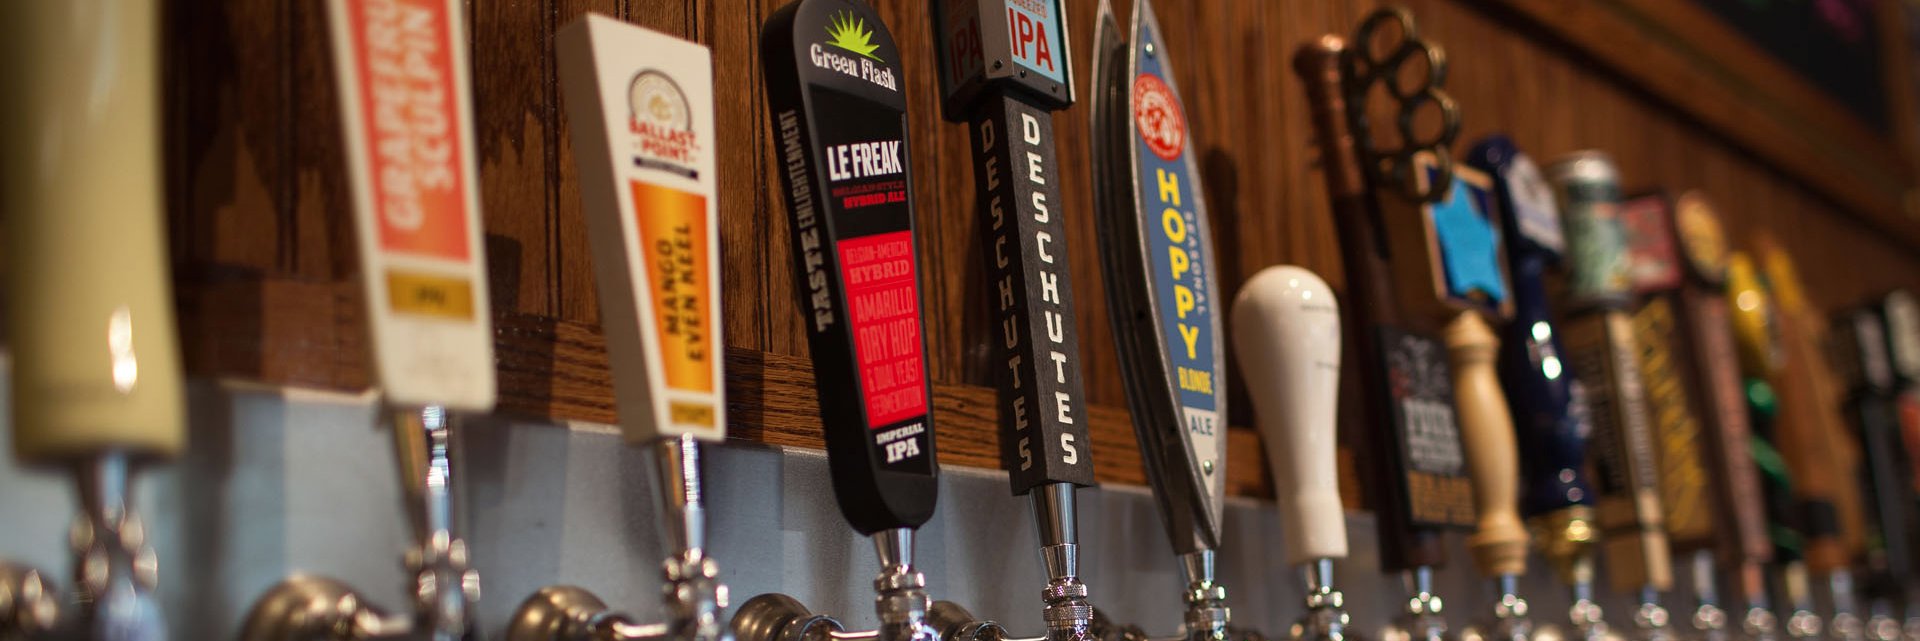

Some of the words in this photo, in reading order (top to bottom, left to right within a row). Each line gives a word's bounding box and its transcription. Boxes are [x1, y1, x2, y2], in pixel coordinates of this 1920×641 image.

[950, 16, 983, 85] IPA
[1009, 6, 1054, 72] IPA
[811, 43, 858, 78] Green
[861, 57, 897, 92] Flash
[402, 7, 455, 190] SCULPIN
[629, 117, 696, 148] BALLAST
[642, 139, 688, 163] POINT
[779, 109, 816, 227] ENLIGHTENMENT
[827, 145, 851, 181] LE
[851, 141, 902, 178] FREAK
[844, 193, 886, 209] HYBRID
[887, 191, 906, 203] ALE
[674, 223, 696, 286] KEEL
[849, 259, 910, 285] HYBRID
[1156, 168, 1199, 360] HOPPY
[1184, 210, 1206, 315] SEASONAL
[656, 239, 680, 336] MANGO
[800, 228, 835, 332] TASTE
[855, 286, 914, 323] AMARILLO
[980, 119, 1033, 472] DESCHUTES
[1021, 112, 1078, 465] DESCHUTES
[682, 297, 704, 362] EVEN
[860, 323, 889, 365] DRY
[889, 317, 916, 358] HOP
[895, 357, 919, 385] YEAST
[1178, 366, 1213, 396] BLONDE
[876, 423, 924, 445] IMPERIAL
[1191, 414, 1213, 436] ALE
[885, 437, 920, 463] IPA
